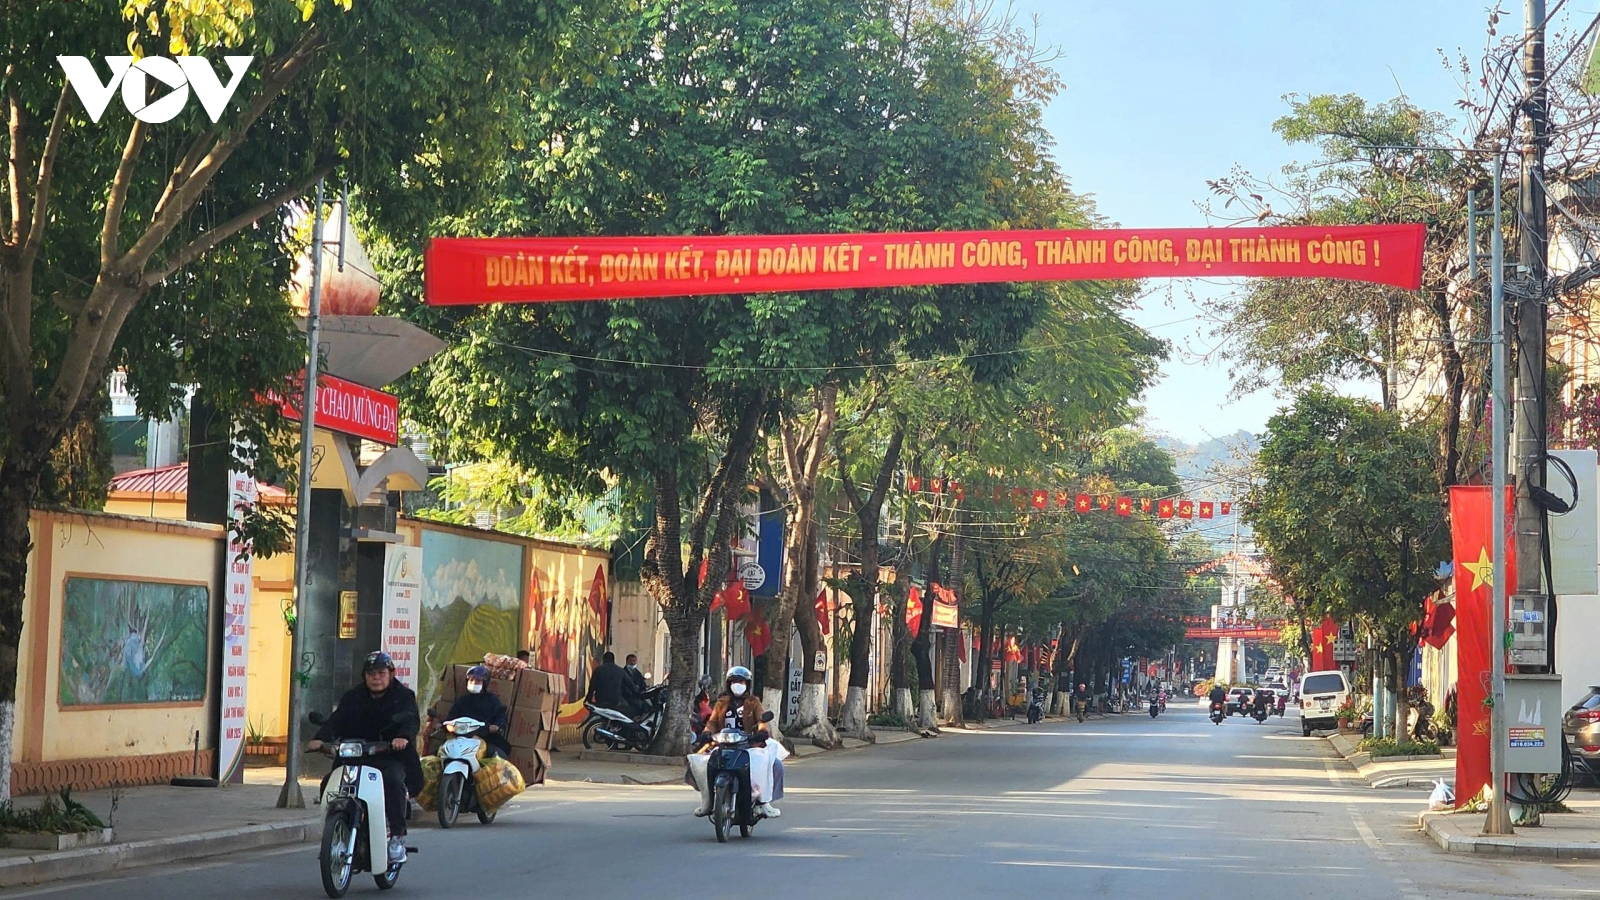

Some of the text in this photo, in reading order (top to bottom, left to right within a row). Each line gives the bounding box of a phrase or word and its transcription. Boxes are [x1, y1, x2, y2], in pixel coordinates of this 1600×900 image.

[486, 251, 544, 287] ĐOÀN
[550, 245, 594, 287] KẾT,
[600, 247, 658, 283] ĐOÀN
[664, 244, 709, 283] KẾT,
[715, 248, 752, 284] ĐẠI
[757, 243, 817, 275] ĐOÀN
[884, 240, 955, 270] THÀNH
[961, 239, 1028, 269] CÔNG,
[1035, 237, 1106, 265] THÀNH
[1113, 236, 1179, 266] CÔNG,
[1186, 238, 1223, 268] ĐẠI
[1229, 235, 1300, 262] THÀNH
[1307, 234, 1366, 265] CÔNG
[1374, 240, 1380, 266] !
